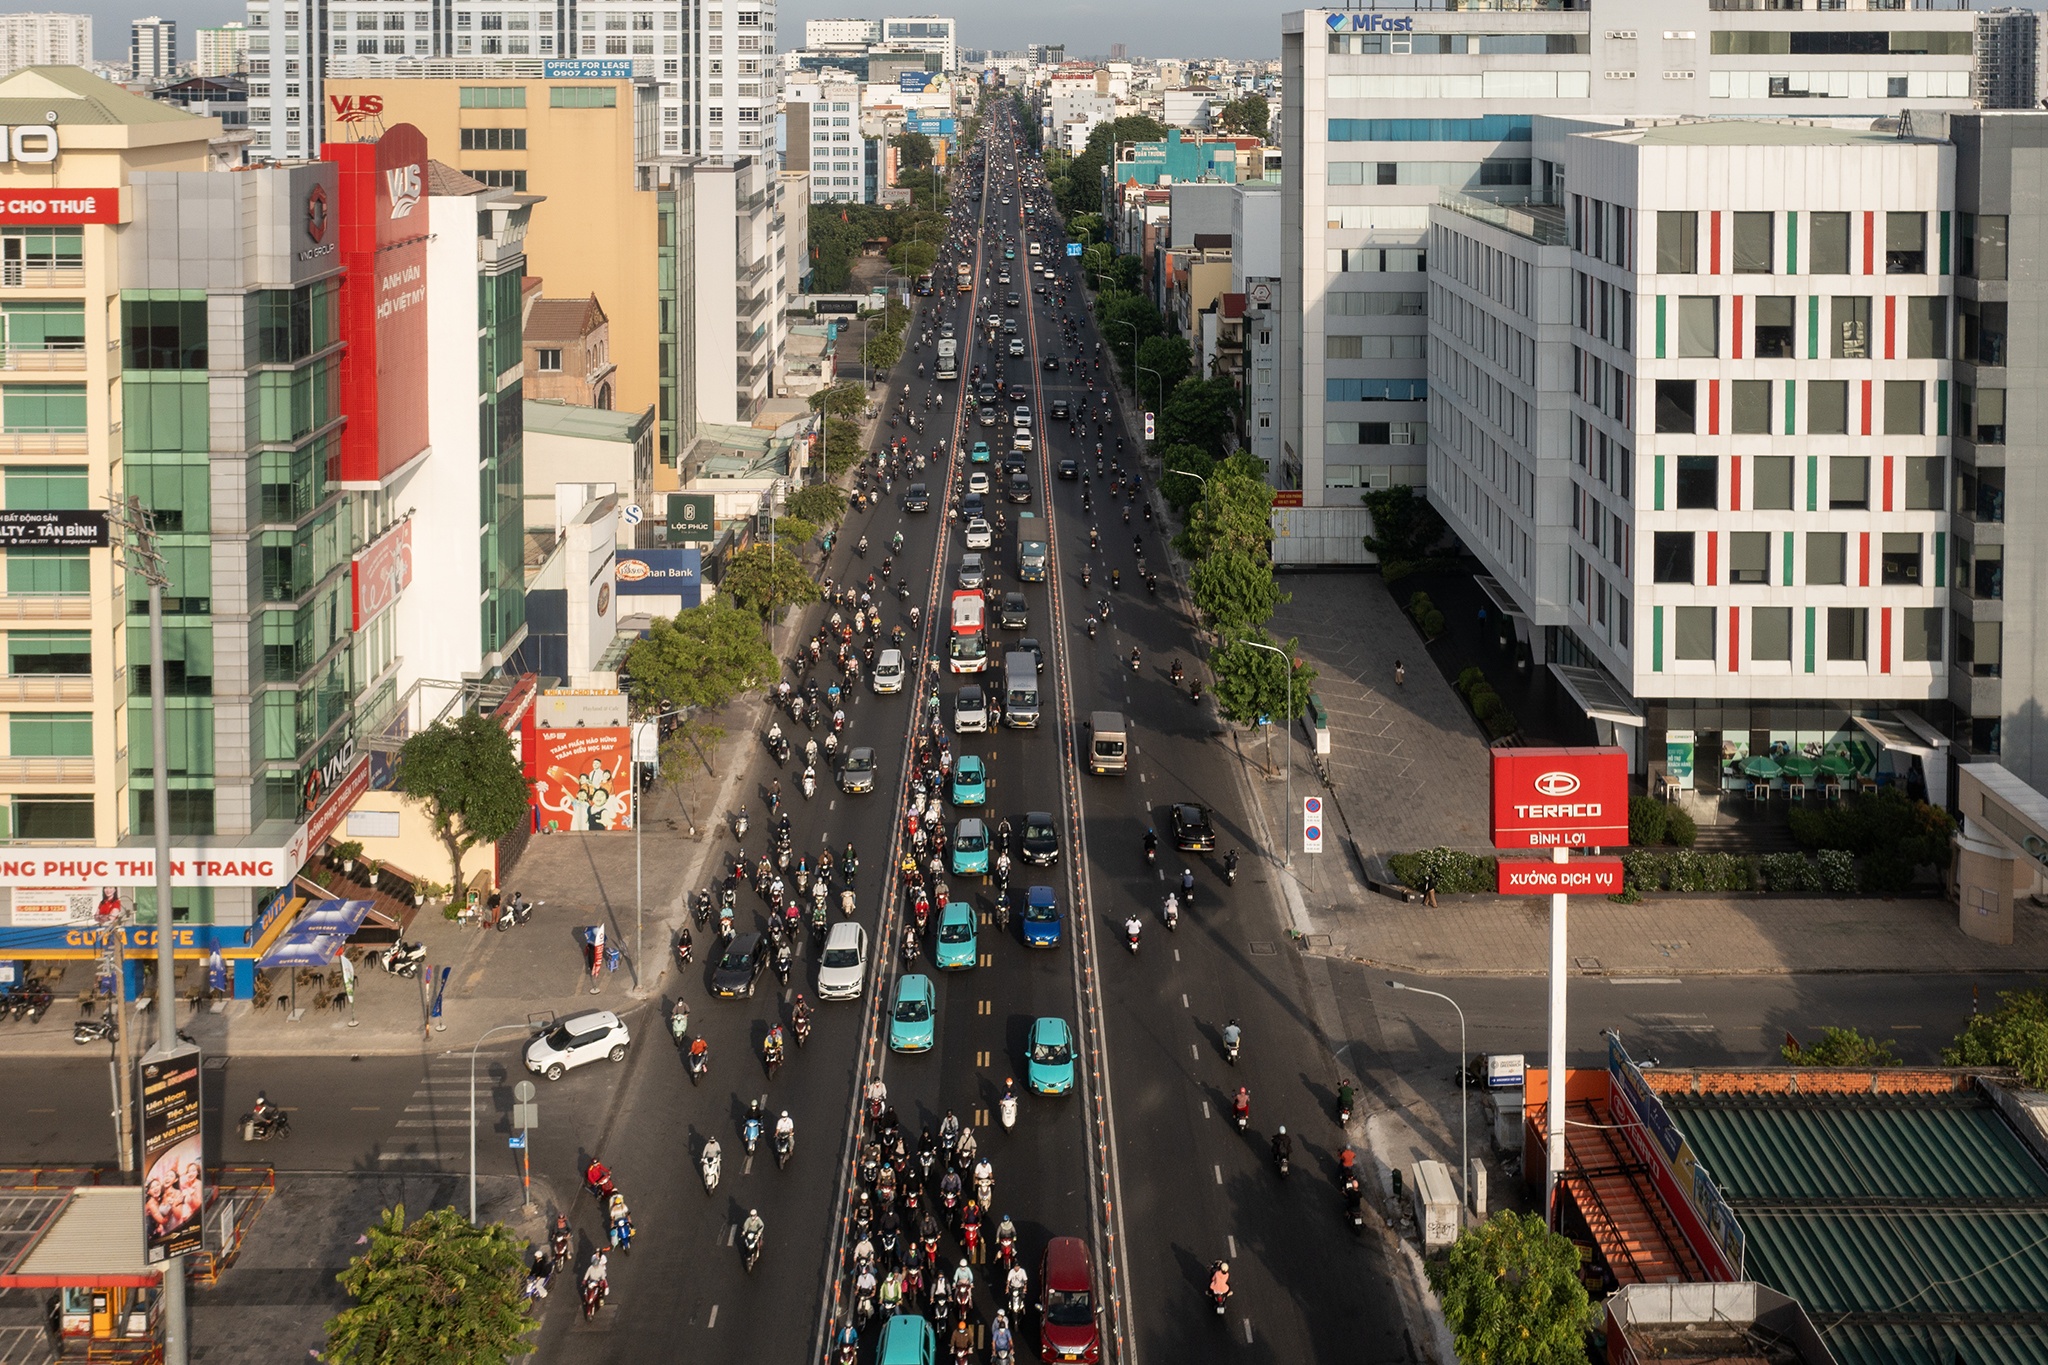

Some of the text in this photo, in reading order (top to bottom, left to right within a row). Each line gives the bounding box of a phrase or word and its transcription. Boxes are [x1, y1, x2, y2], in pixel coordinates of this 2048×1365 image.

[1352, 14, 1413, 32] MFast
[330, 95, 384, 114] VUS
[386, 164, 421, 207] VUS
[8, 200, 46, 213] CHO
[49, 196, 96, 214] THUÊ
[382, 265, 421, 291] ANH VĂN
[377, 286, 426, 320] HỘI VIỆT MỸ
[4, 513, 58, 523] BẤT ĐỘNG SẢN
[671, 522, 708, 531] LỘC PHÚC
[0, 526, 25, 536] LTY
[37, 523, 64, 536] TÂN
[66, 523, 97, 536] BÌNH
[669, 568, 693, 577] Bank
[351, 767, 367, 791] TRANG
[1514, 804, 1601, 818] TERACO
[1530, 832, 1586, 846] BÌNH LỢI
[0, 861, 274, 881] NG PHỤC THIN TRANG
[1510, 870, 1613, 886] XƯỞNG DỊCH VỤ
[262, 893, 286, 931] GUTA
[146, 1090, 187, 1111] Liên Hoan
[185, 1101, 198, 1111] Vui
